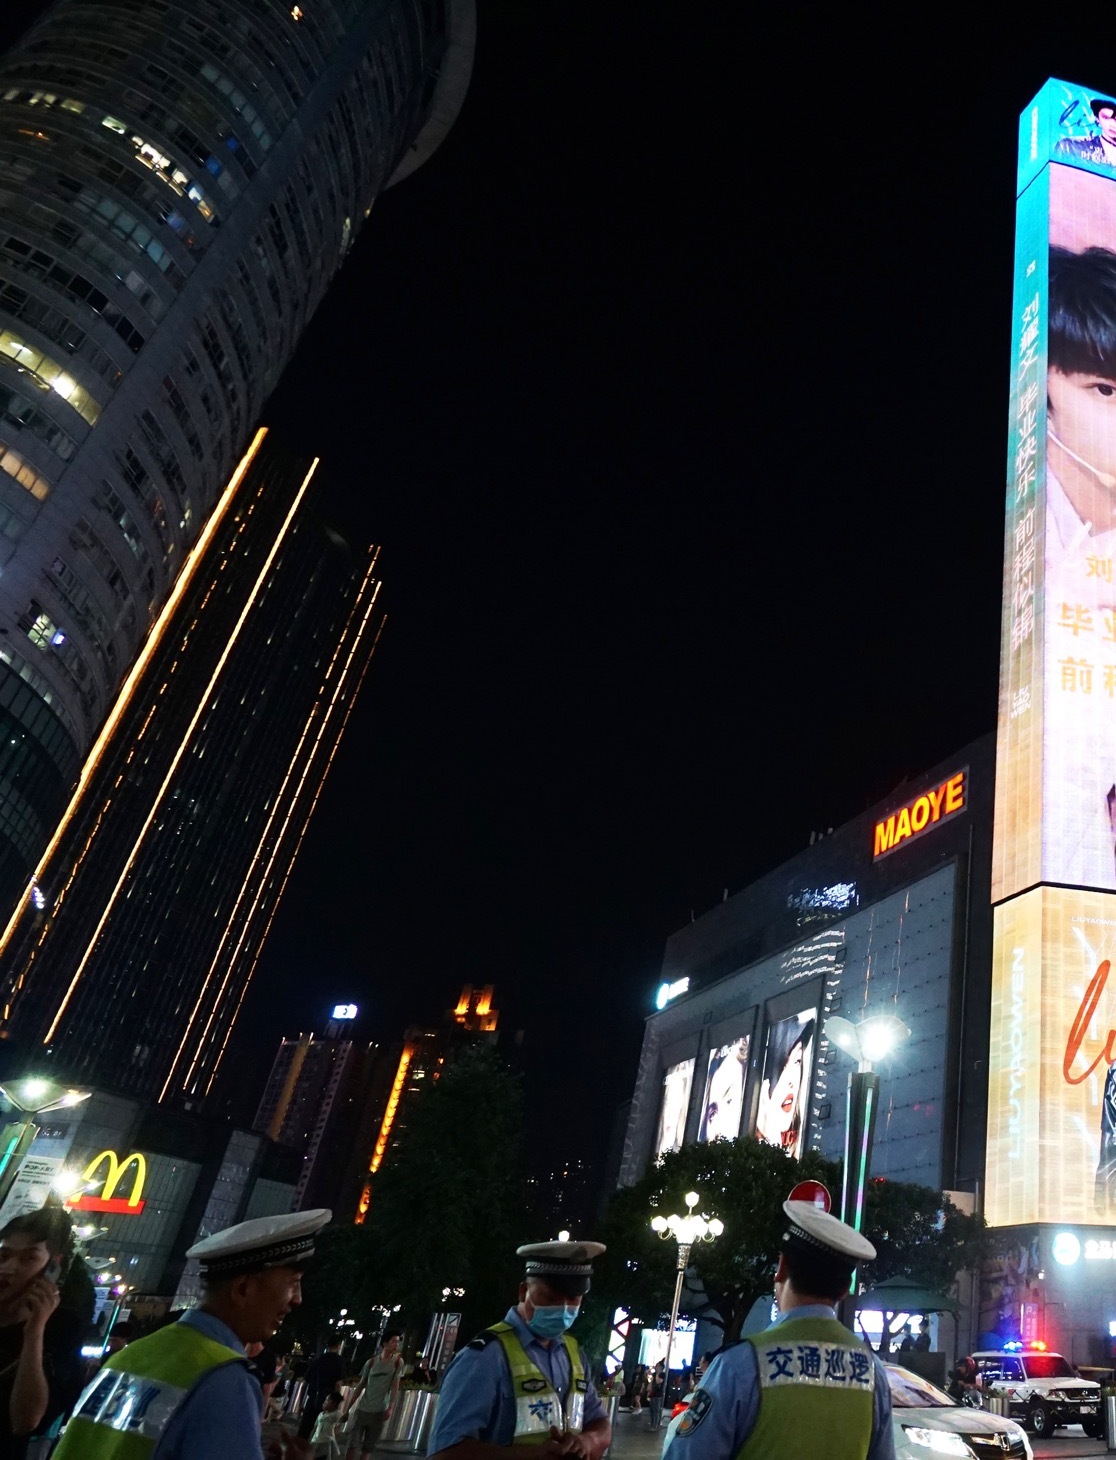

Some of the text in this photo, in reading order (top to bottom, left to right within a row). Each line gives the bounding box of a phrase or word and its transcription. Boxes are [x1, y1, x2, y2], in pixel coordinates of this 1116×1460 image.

[874, 771, 964, 858] MAOYE
[766, 1345, 871, 1384] 交通巡逻
